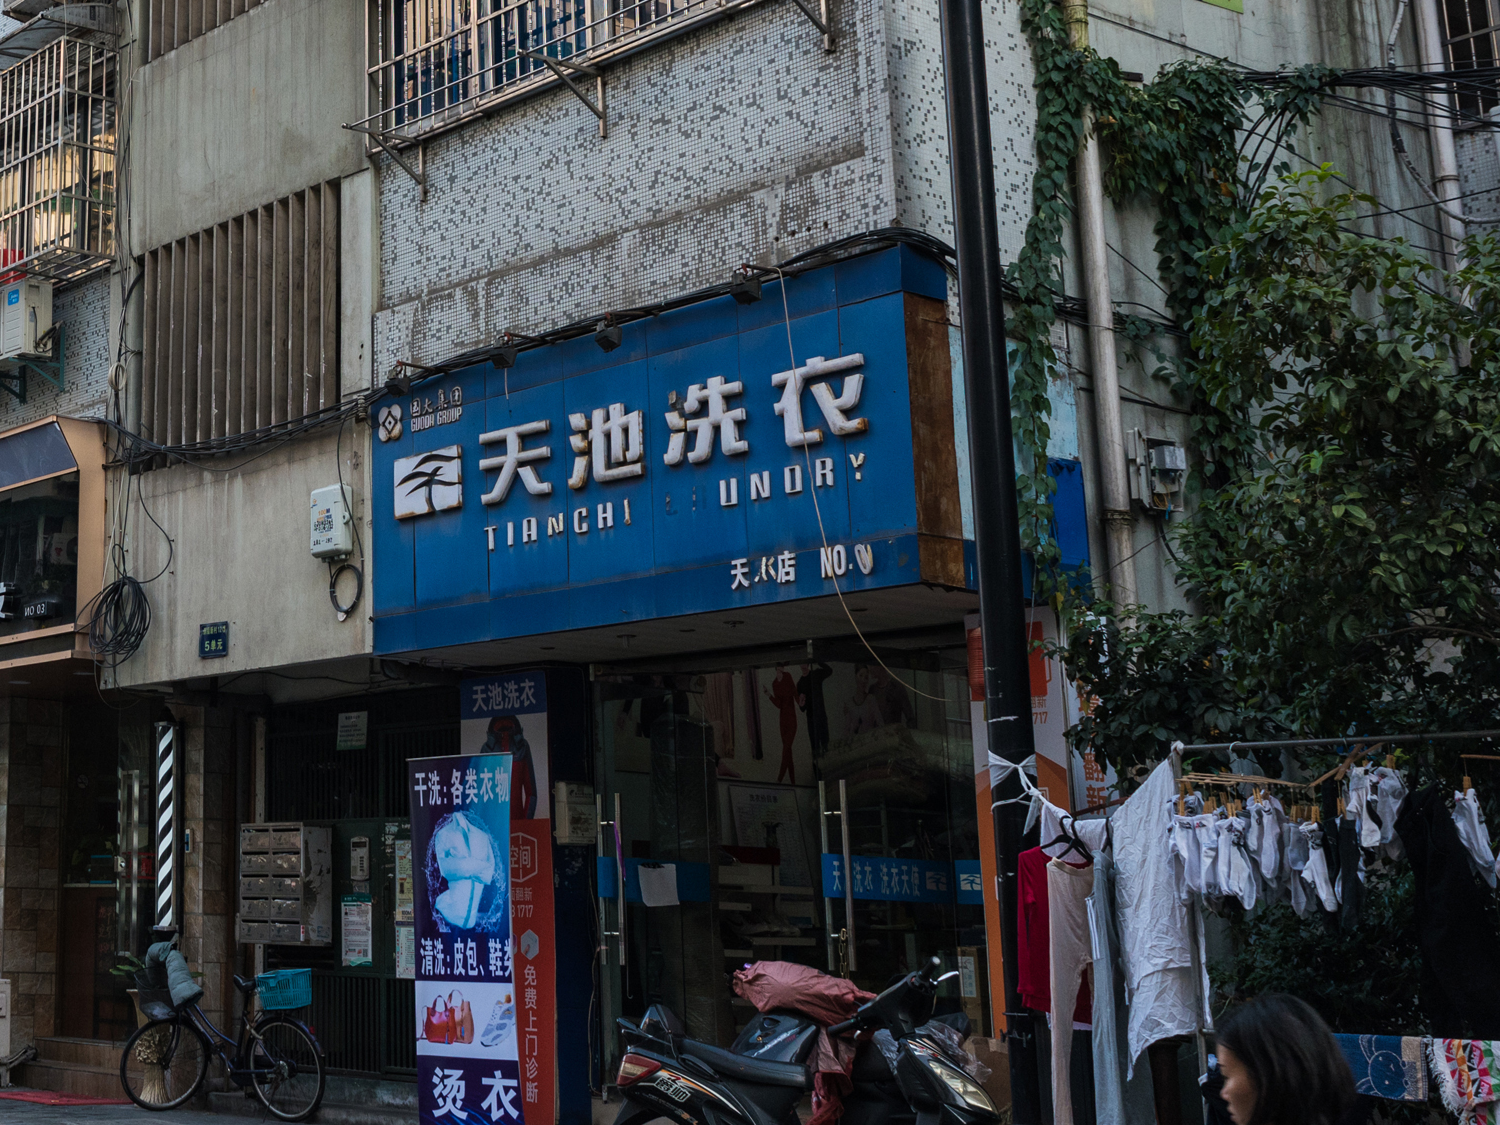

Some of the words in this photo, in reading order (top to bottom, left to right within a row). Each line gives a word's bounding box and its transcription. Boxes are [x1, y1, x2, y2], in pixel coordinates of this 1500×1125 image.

[410, 386, 462, 417] 国大集团
[410, 413, 436, 433] GUODA
[436, 407, 462, 426] GROUP
[478, 352, 869, 506] 天池洗衣
[484, 497, 631, 551] TIANCHI
[36, 603, 46, 615] 03
[204, 638, 223, 652] 5单元
[472, 679, 536, 713] 天池洗衣
[832, 860, 873, 893] 天洗衣
[880, 862, 920, 897] 洗衣天使
[524, 965, 539, 1104] 免费上门诊断
[431, 1066, 520, 1122] 烫衣
